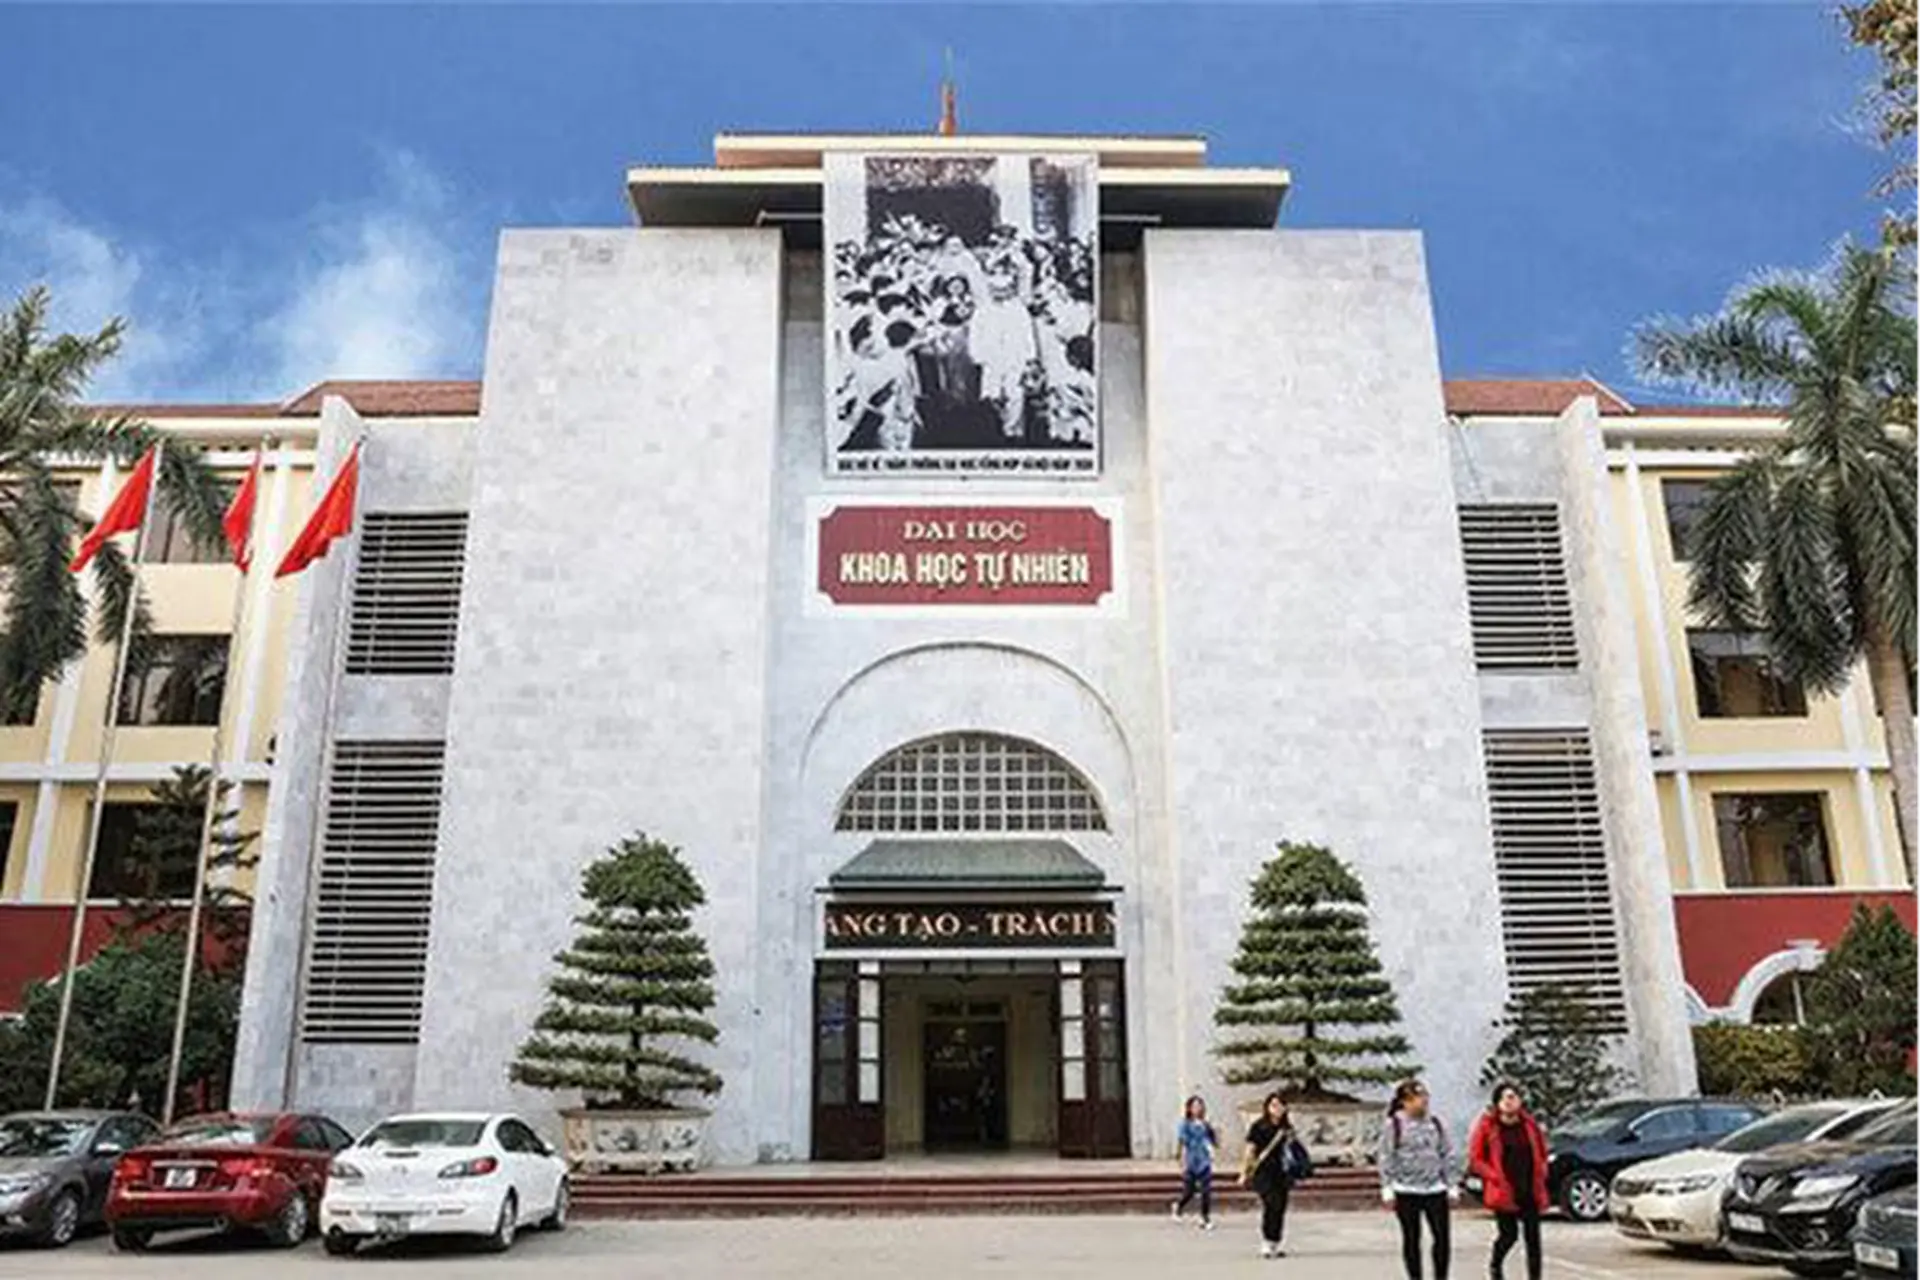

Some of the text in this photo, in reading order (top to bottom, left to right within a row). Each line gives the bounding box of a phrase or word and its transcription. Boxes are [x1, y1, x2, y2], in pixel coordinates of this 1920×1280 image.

[840, 547, 1089, 590] KHOA HỌC TỰ NHIÊN
[893, 911, 960, 941] TẠO
